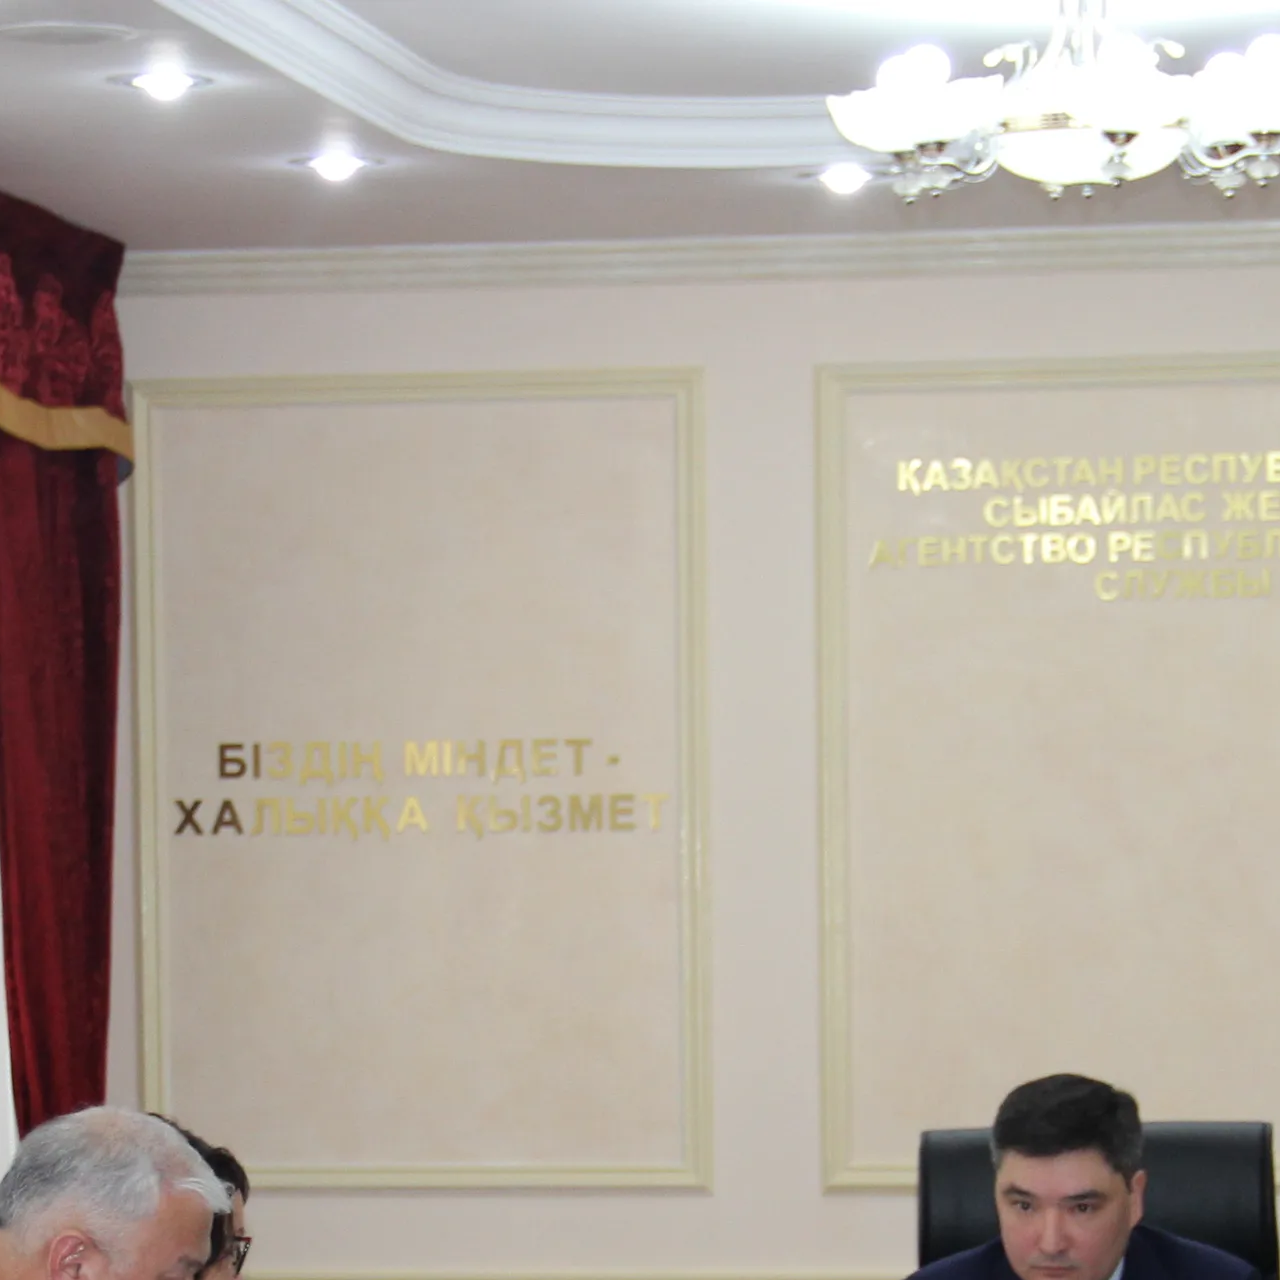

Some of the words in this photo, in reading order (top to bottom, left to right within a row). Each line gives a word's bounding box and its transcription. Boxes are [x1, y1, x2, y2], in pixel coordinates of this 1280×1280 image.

[896, 456, 1123, 496] ҚАЗАҚСТАН
[983, 490, 1206, 527] СЫБАЙЛАС
[869, 532, 1098, 568] АГЕНТСТВО
[1094, 567, 1270, 601] СЛУЖБЫ
[217, 740, 384, 785] БІЗДІҢ
[405, 738, 593, 784] МІНДЕТ
[174, 796, 429, 841] ХАЛЫҚҚА
[456, 794, 670, 841] ҚЫЗМЕТ
